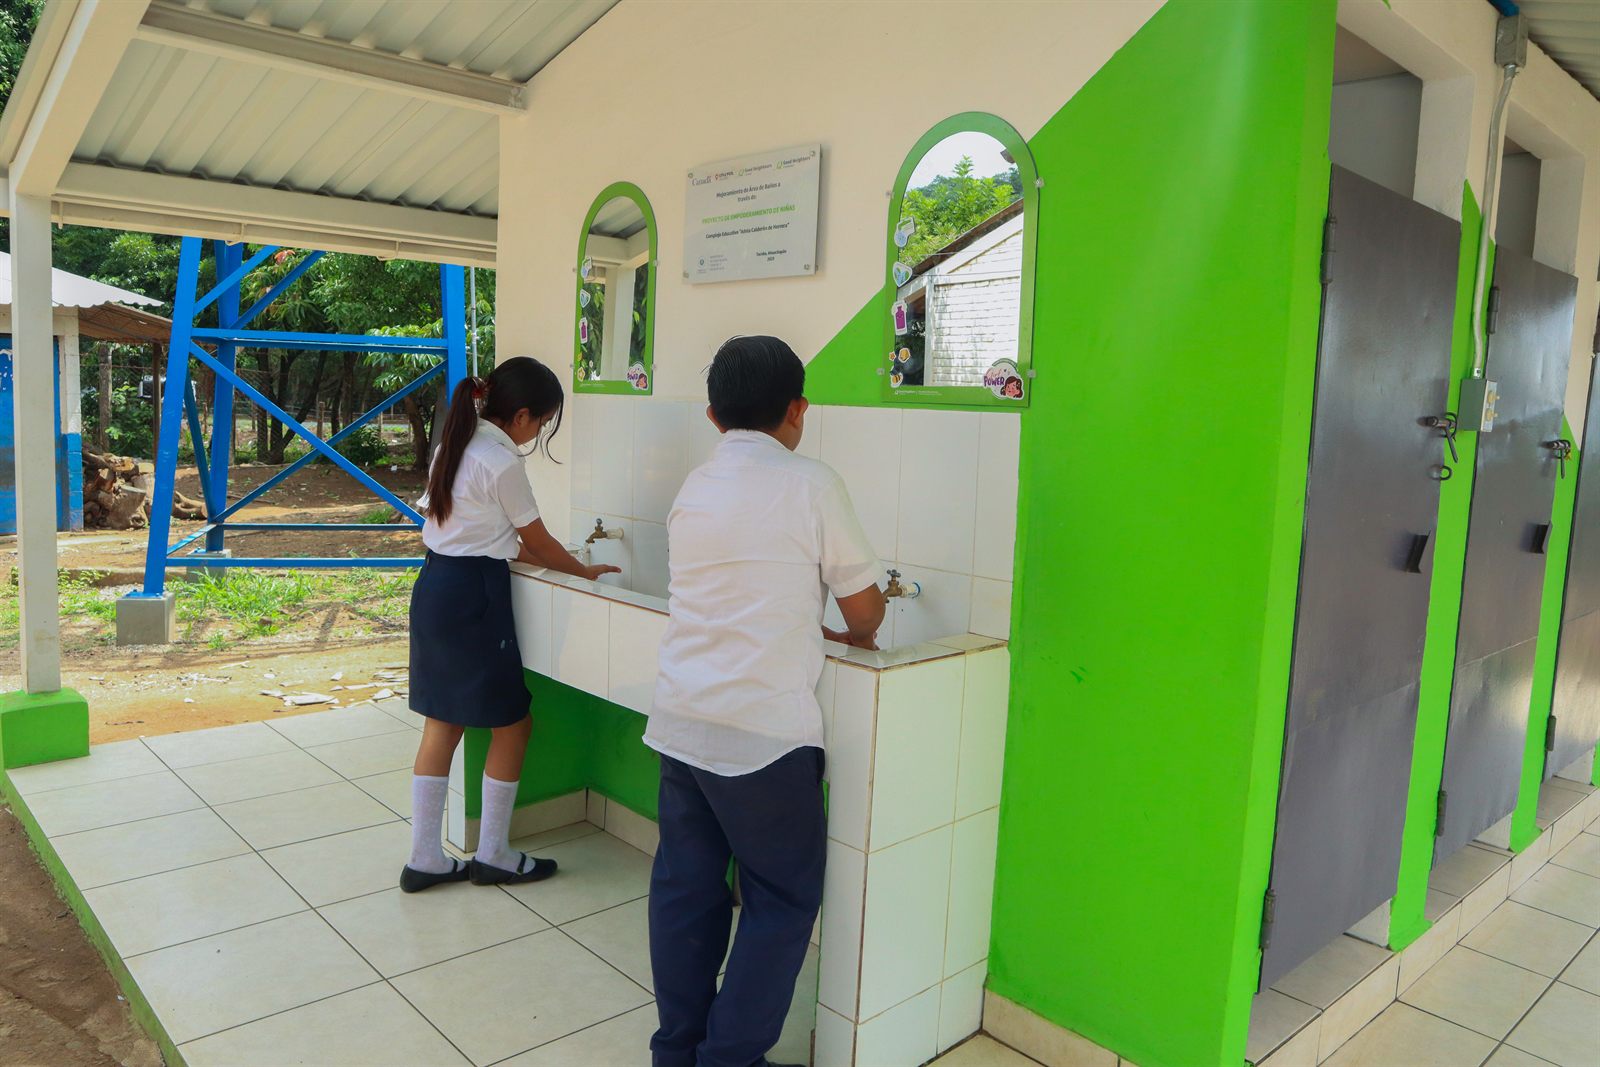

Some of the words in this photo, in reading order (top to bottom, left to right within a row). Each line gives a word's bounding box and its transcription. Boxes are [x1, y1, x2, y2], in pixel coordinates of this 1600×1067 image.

[716, 189, 743, 198] Mejoramiento
[702, 215, 724, 224] PROYECTO
[730, 208, 773, 220] EMPODERAMIENTO
[780, 203, 795, 212] NIÑAS
[984, 375, 1005, 387] POWER
